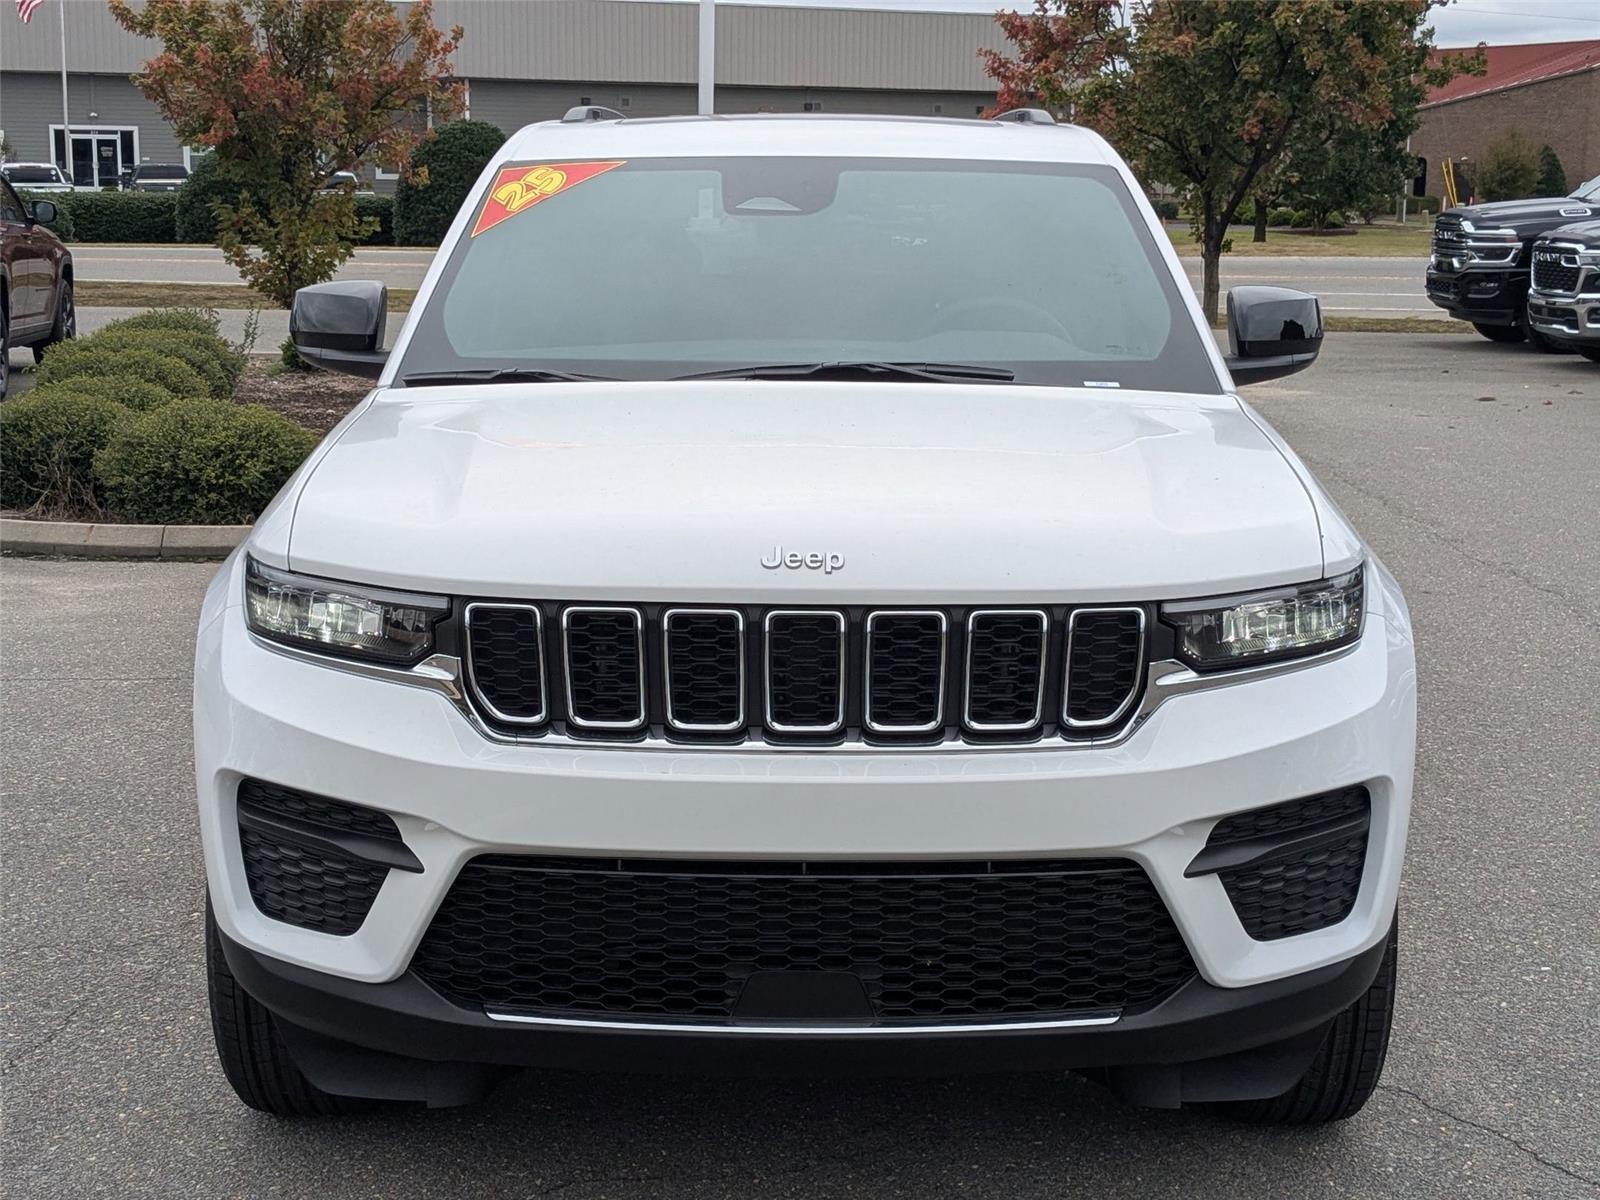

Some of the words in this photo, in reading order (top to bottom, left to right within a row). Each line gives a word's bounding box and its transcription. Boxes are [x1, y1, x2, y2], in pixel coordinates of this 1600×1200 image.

[492, 166, 567, 212] 25
[1535, 251, 1560, 262] RAM
[761, 545, 845, 574] Jeep
